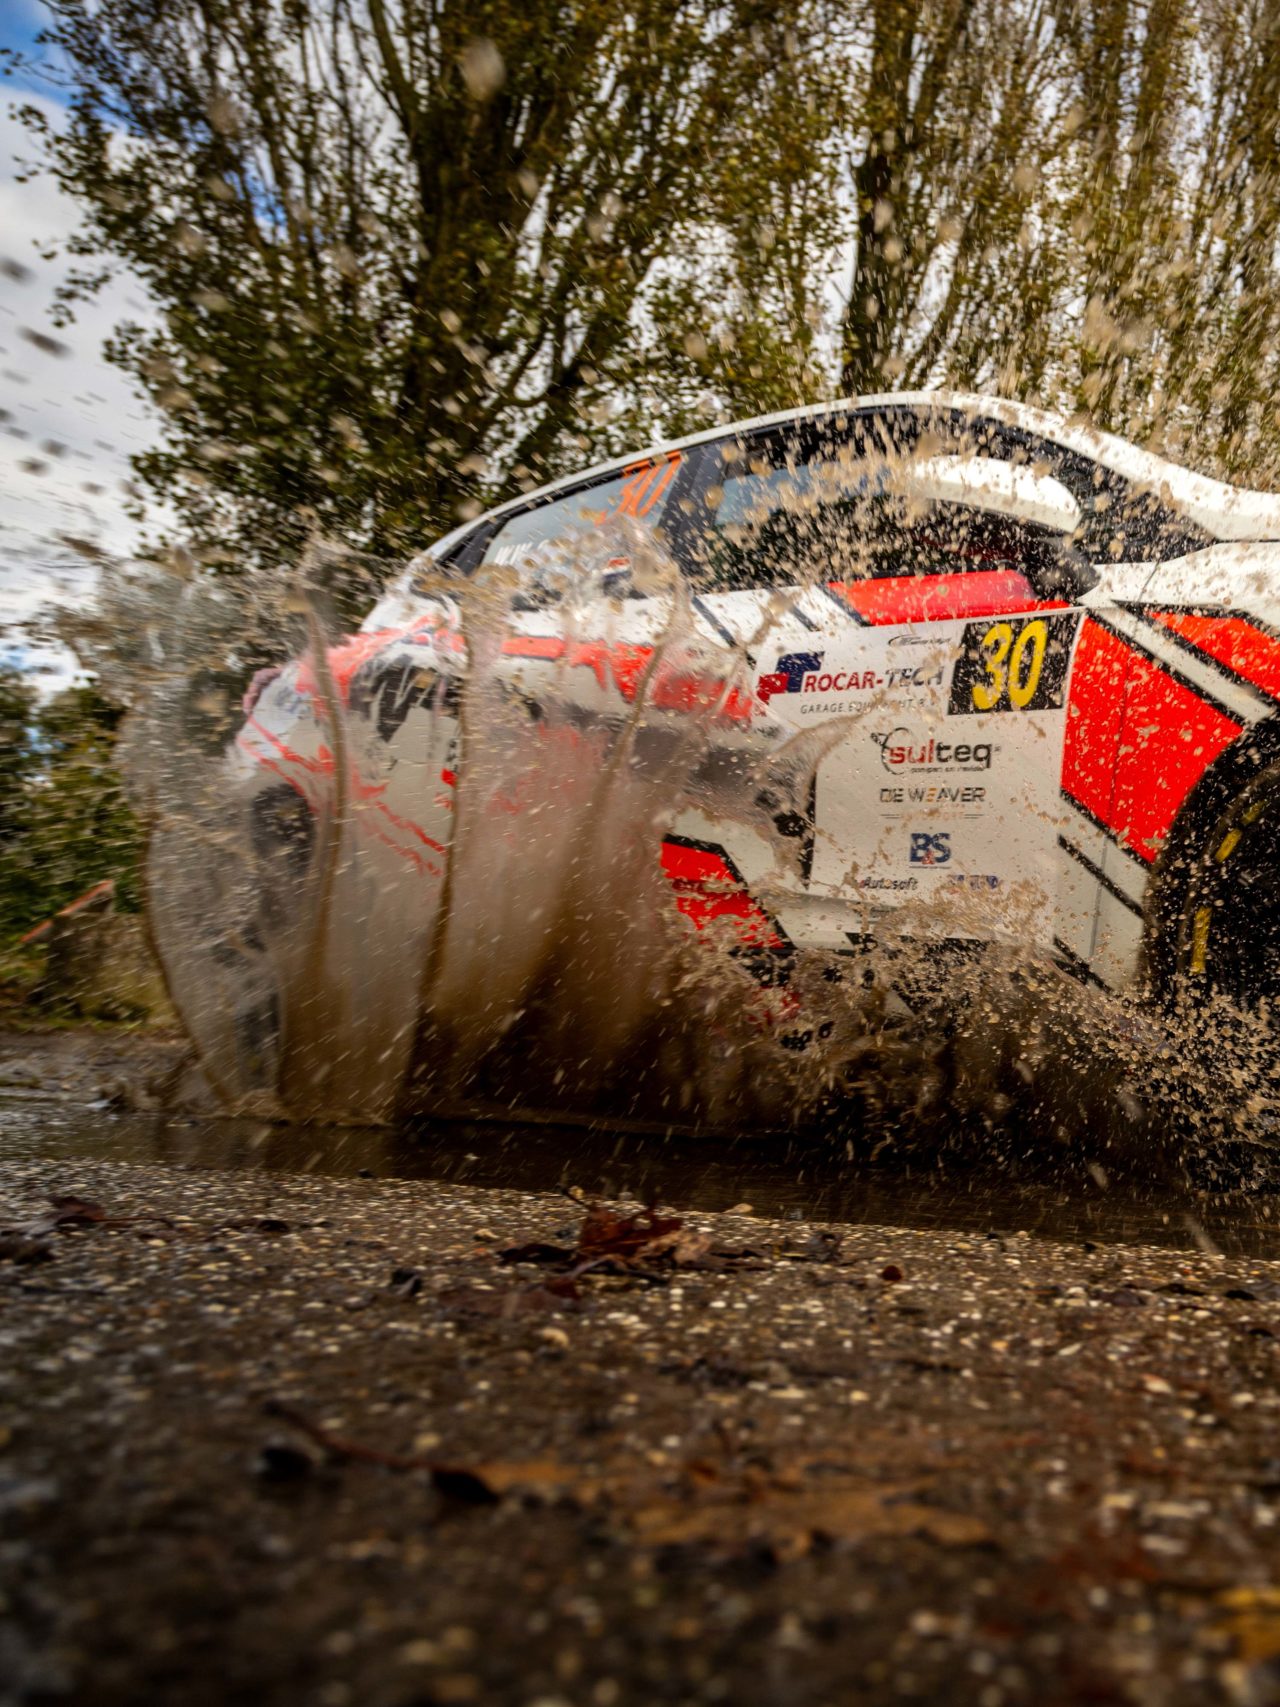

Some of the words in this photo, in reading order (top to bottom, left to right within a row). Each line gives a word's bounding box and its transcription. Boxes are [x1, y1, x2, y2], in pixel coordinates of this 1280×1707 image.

[803, 665, 944, 693] ROCAR-TECH
[971, 619, 1048, 711] 30
[800, 703, 844, 715] GARAGE
[888, 738, 992, 769] sulteq
[880, 787, 904, 802] DE
[908, 787, 986, 802] WEAVER
